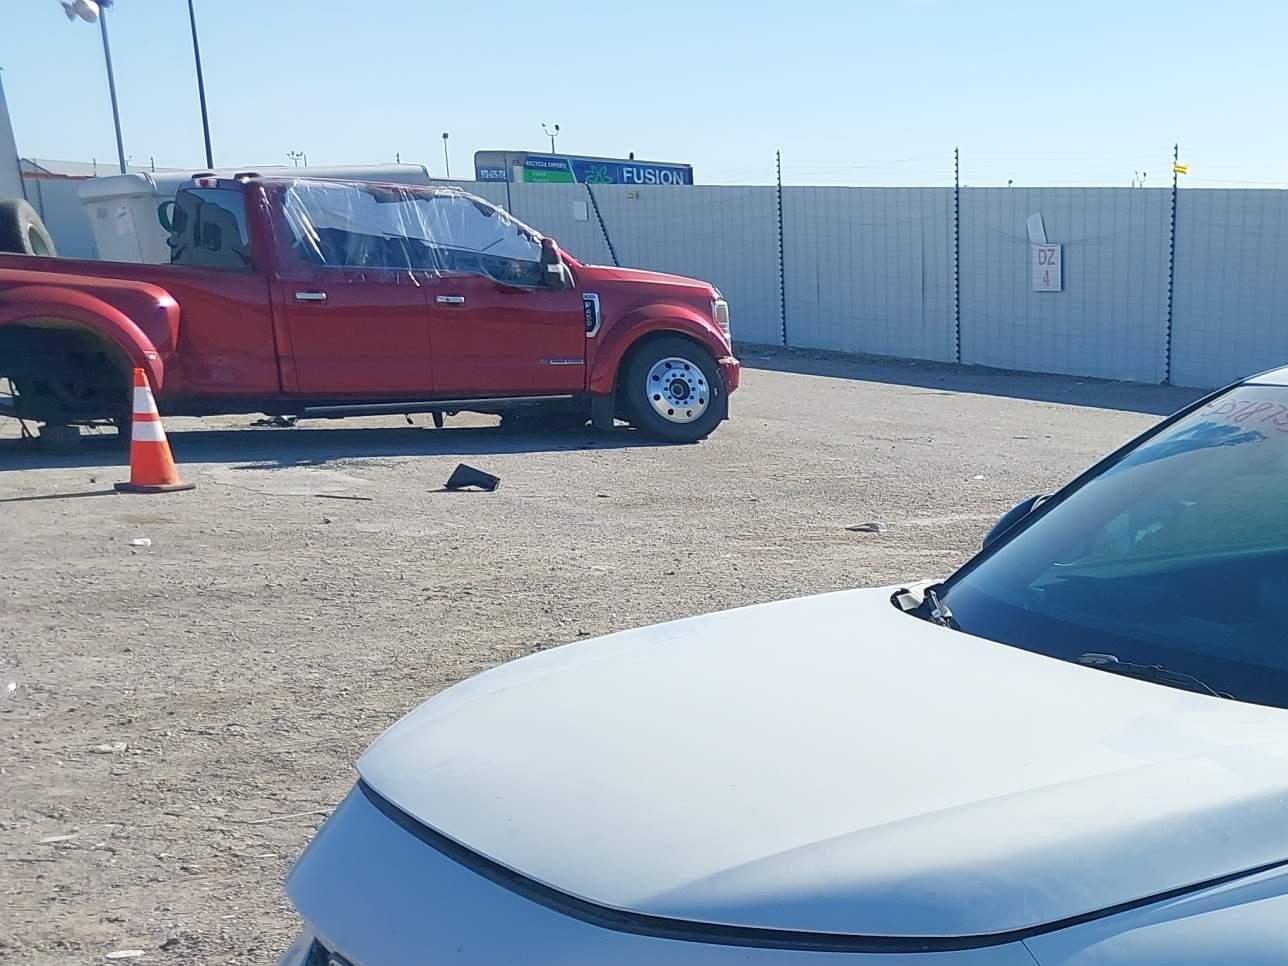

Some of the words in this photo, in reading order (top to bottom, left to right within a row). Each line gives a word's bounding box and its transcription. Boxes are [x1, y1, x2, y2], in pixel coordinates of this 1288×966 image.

[623, 167, 684, 185] FUSION
[1038, 249, 1056, 266] DZ
[1042, 269, 1050, 287] 4
